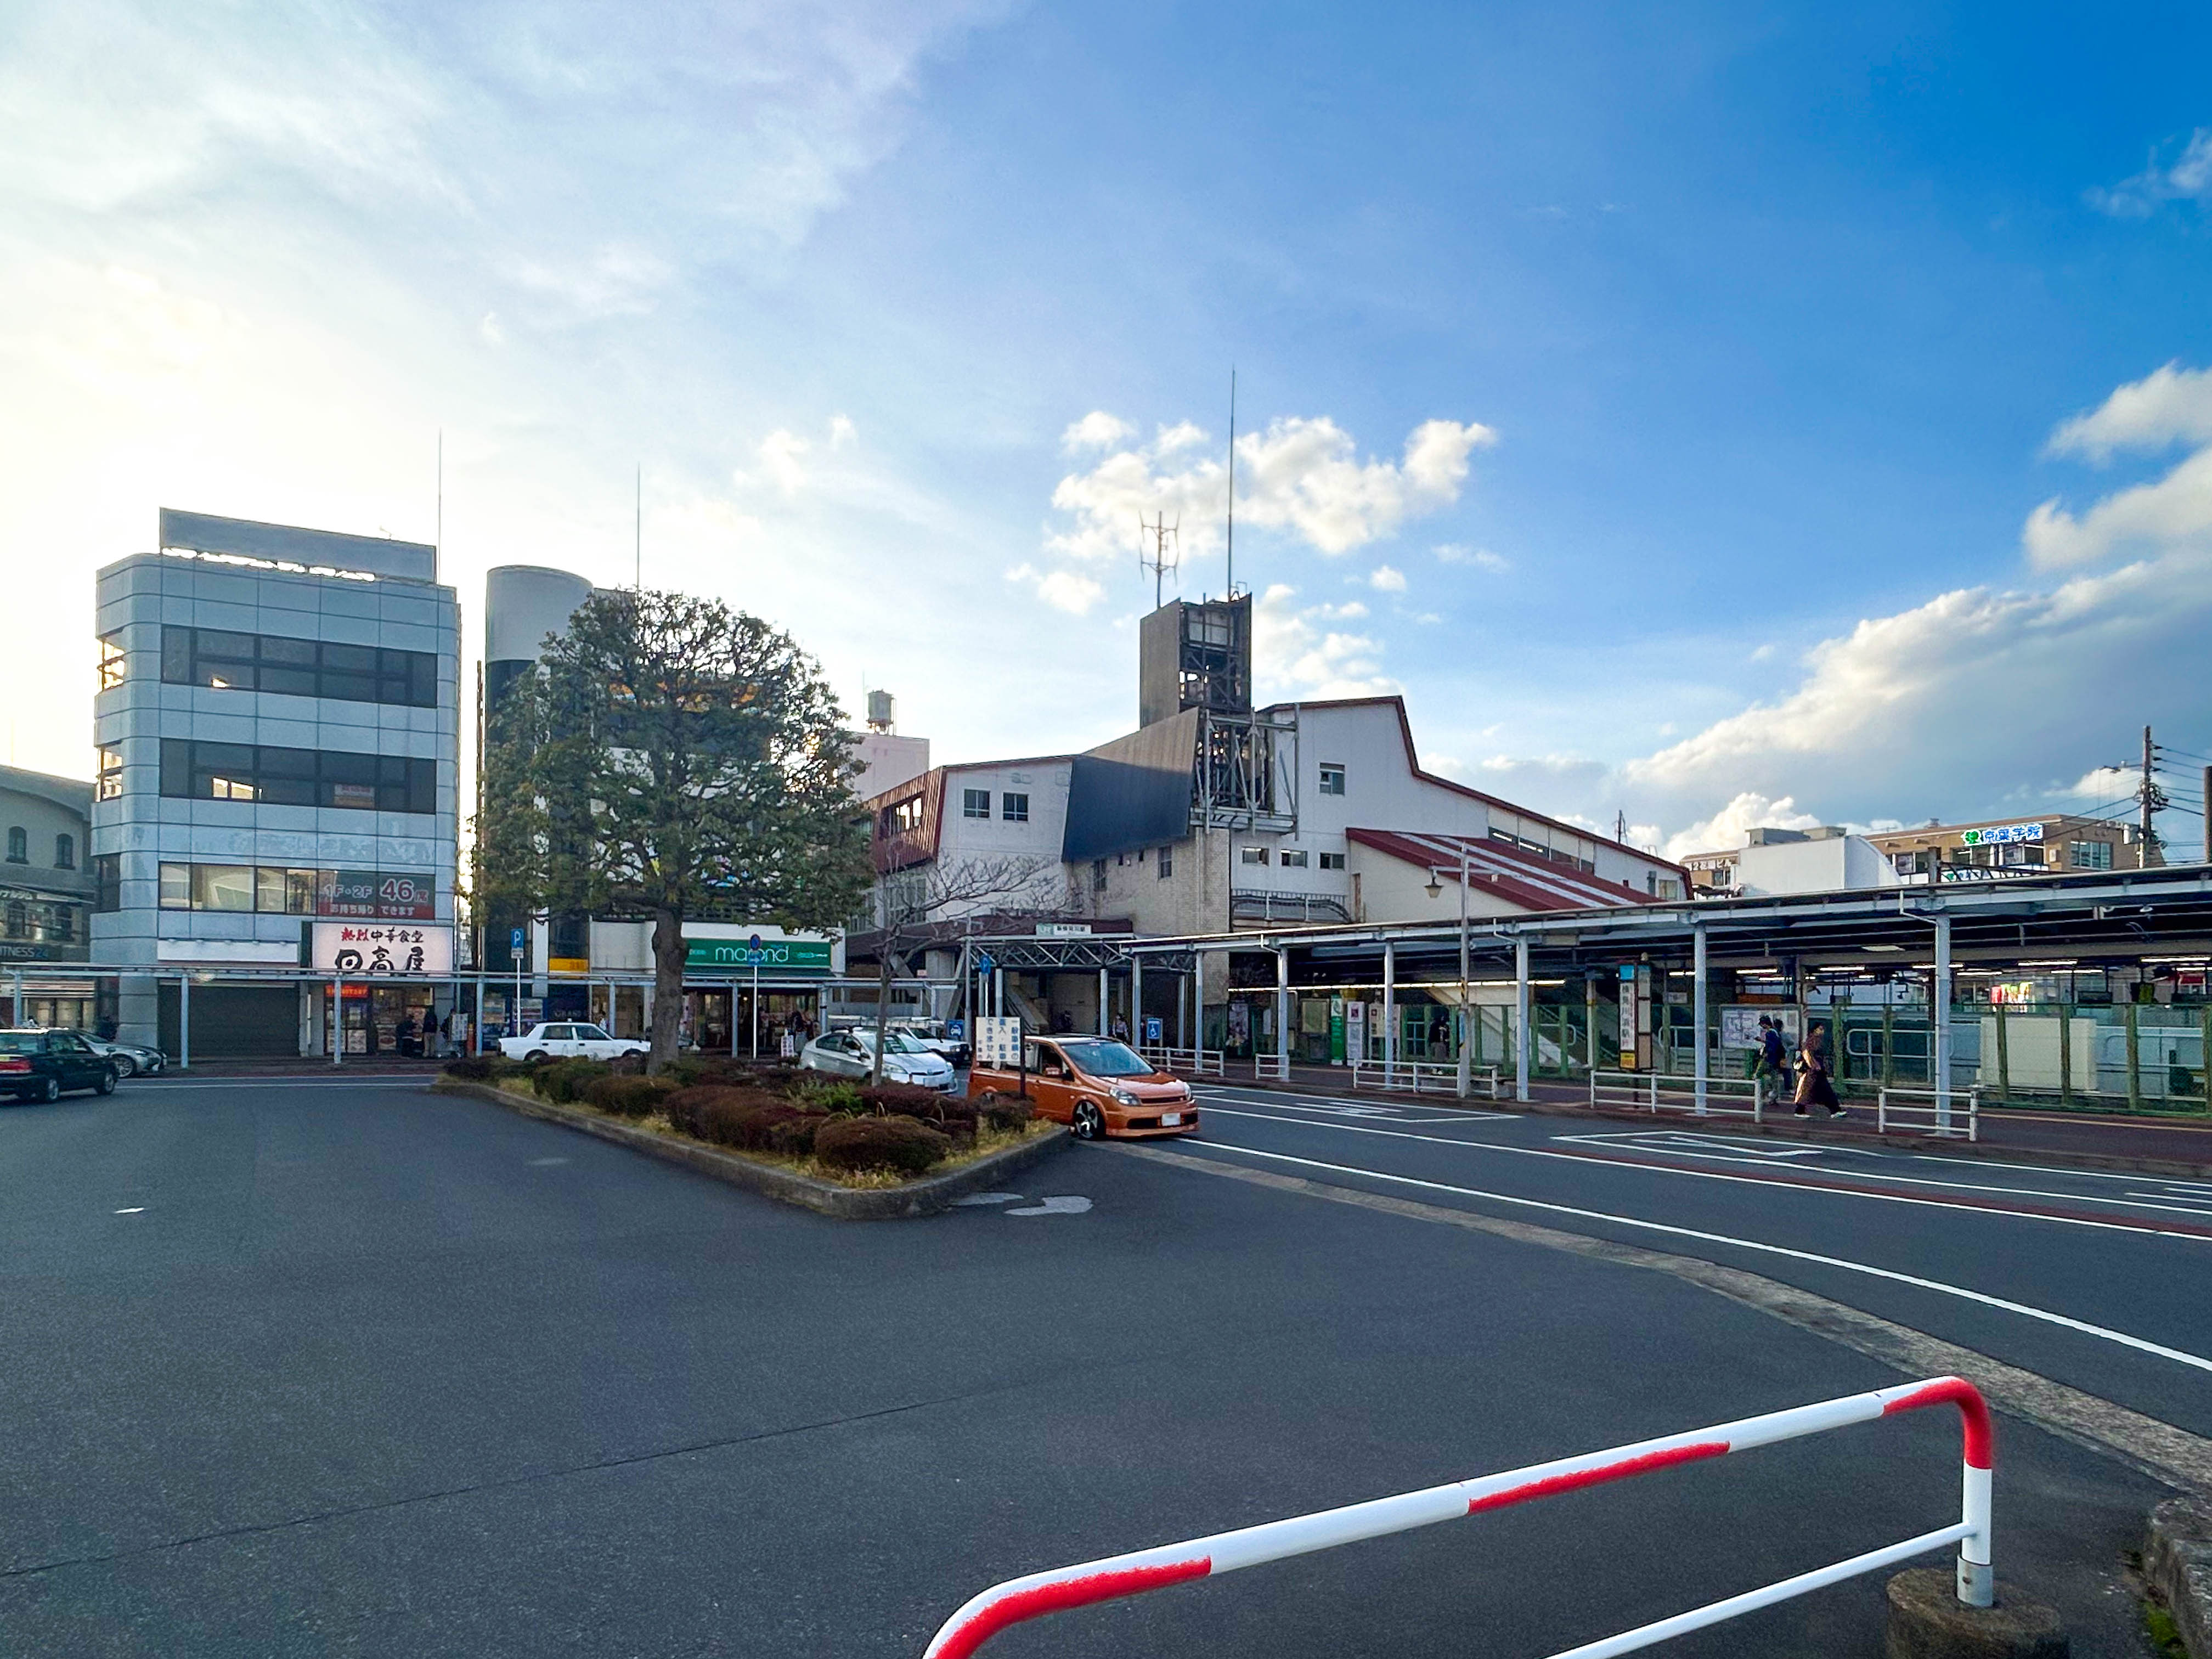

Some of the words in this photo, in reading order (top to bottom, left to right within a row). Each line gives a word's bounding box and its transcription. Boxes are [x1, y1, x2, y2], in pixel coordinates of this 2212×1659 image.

[1983, 825, 2042, 843] 京葉学院
[341, 926, 424, 943] 熱烈中華食堂
[335, 946, 425, 974] 日高屋
